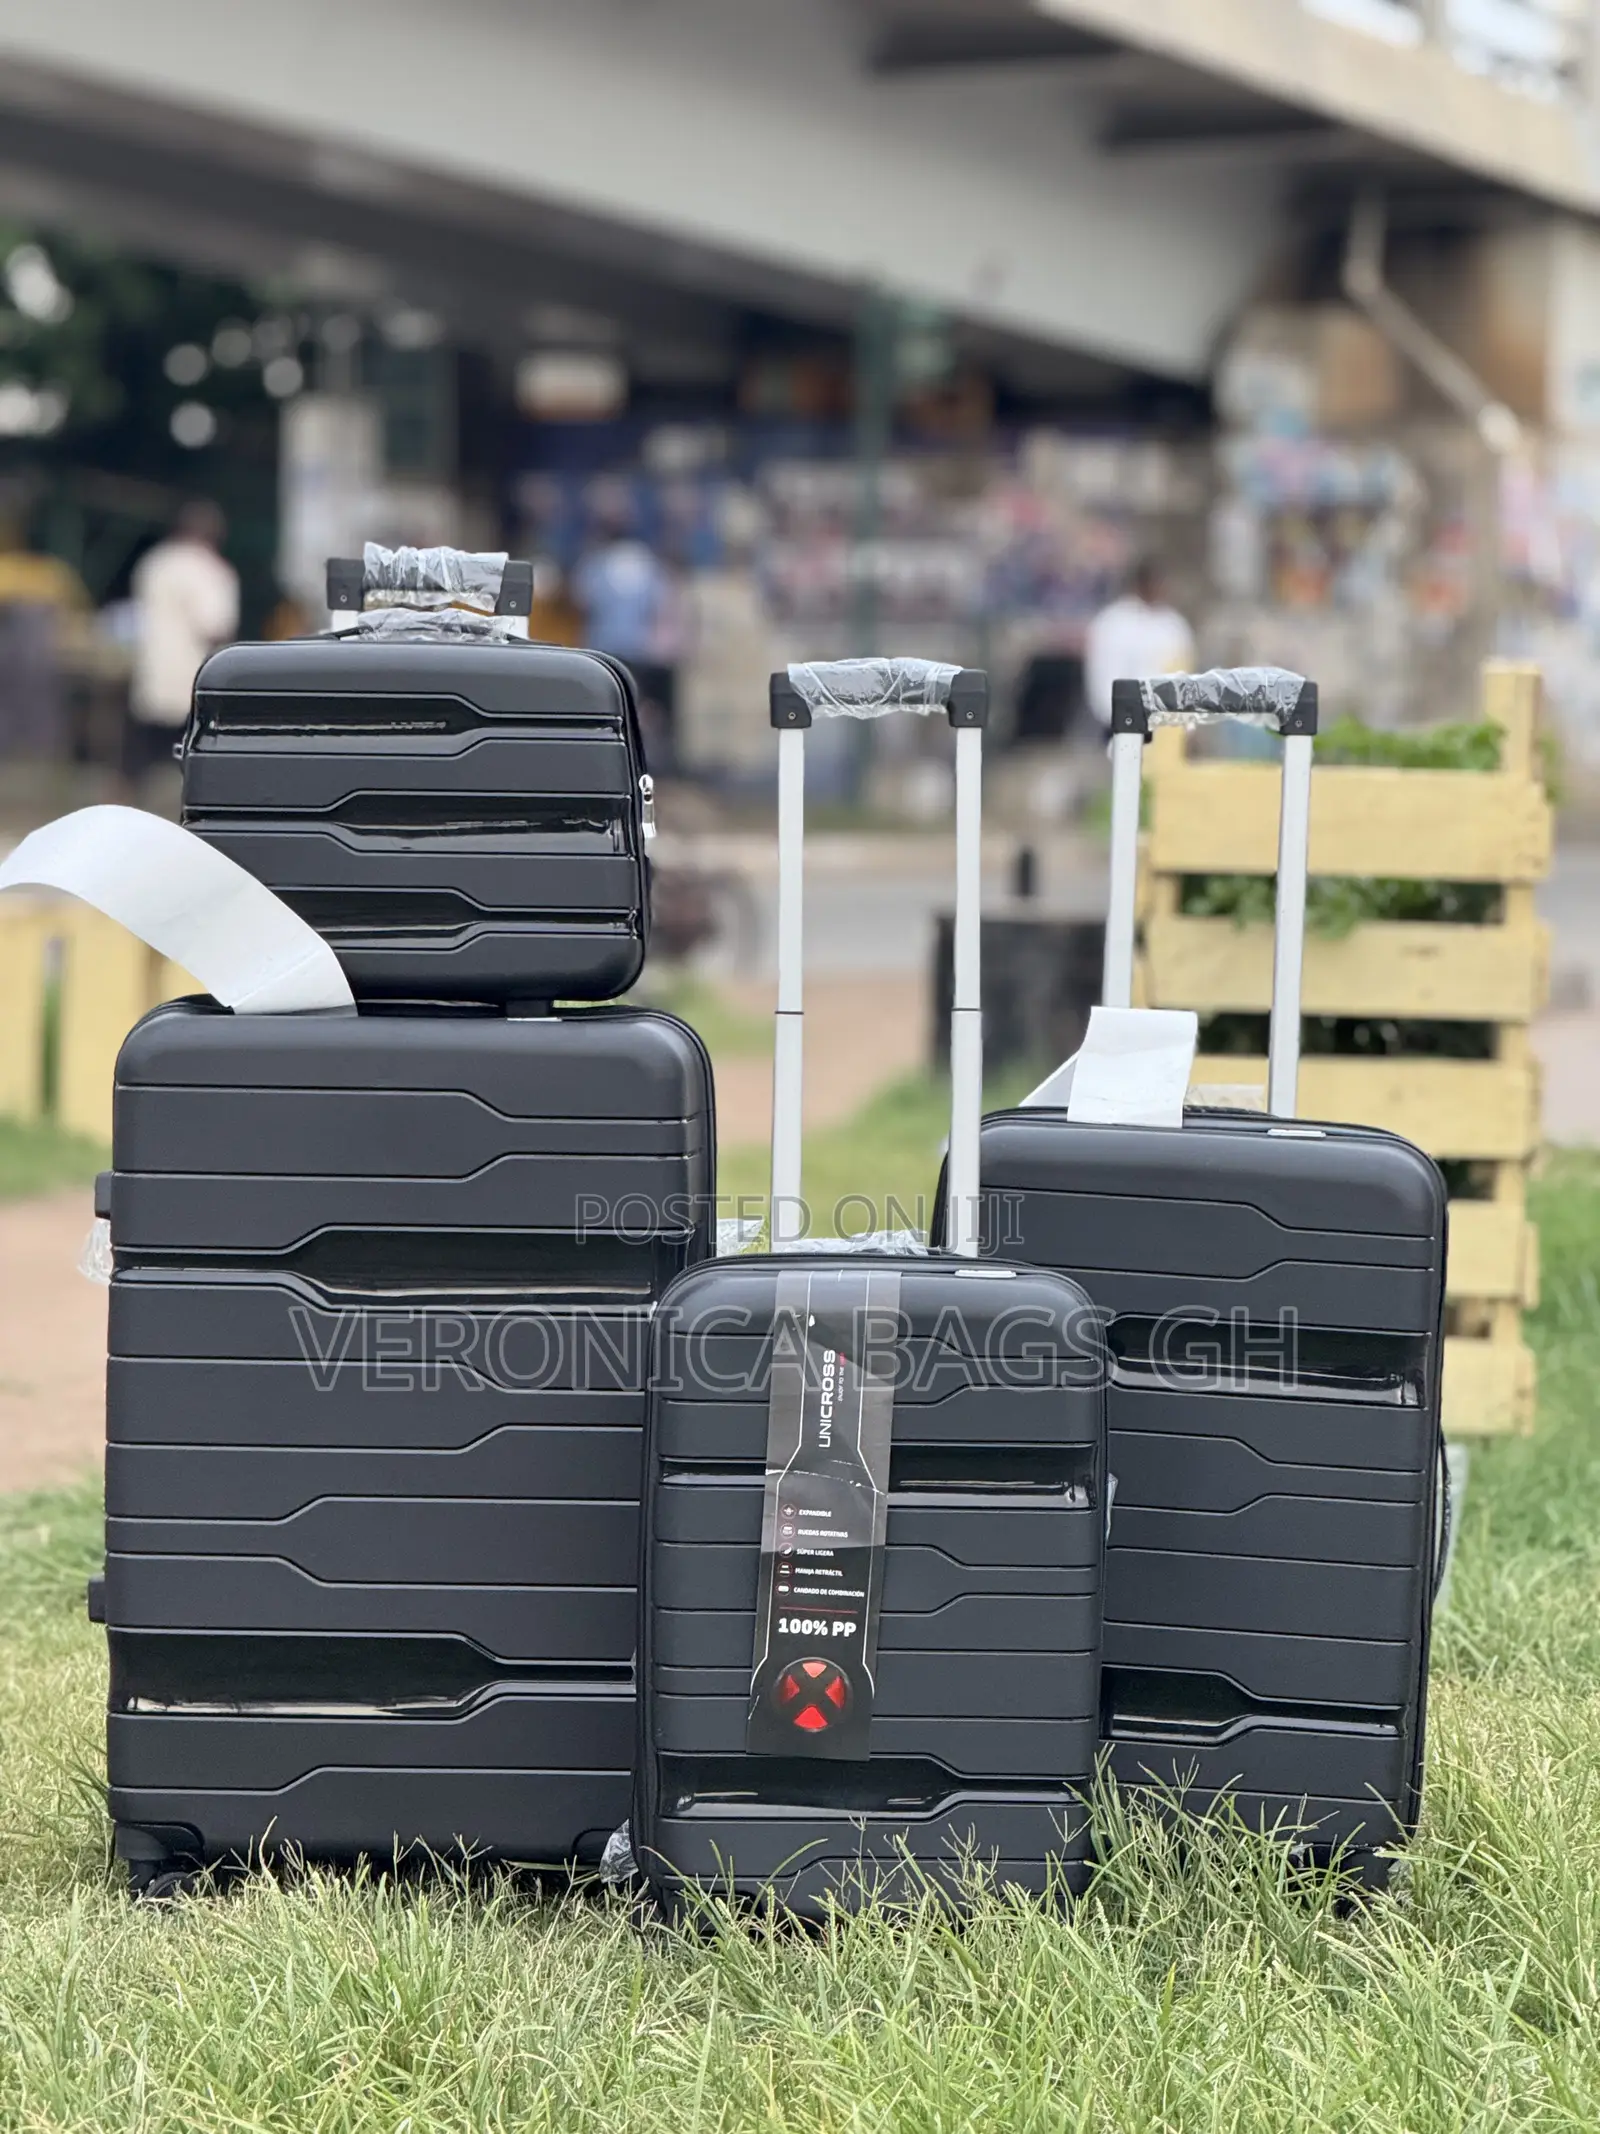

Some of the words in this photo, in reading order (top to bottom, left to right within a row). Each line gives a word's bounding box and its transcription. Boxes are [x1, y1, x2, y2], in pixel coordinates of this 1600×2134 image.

[818, 1349, 835, 1448] UNICROSS
[798, 1509, 832, 1518] EXPANDIBLE
[820, 1530, 848, 1538] ROTATIVAS
[778, 1618, 828, 1636] 100%
[832, 1622, 857, 1638] PP
